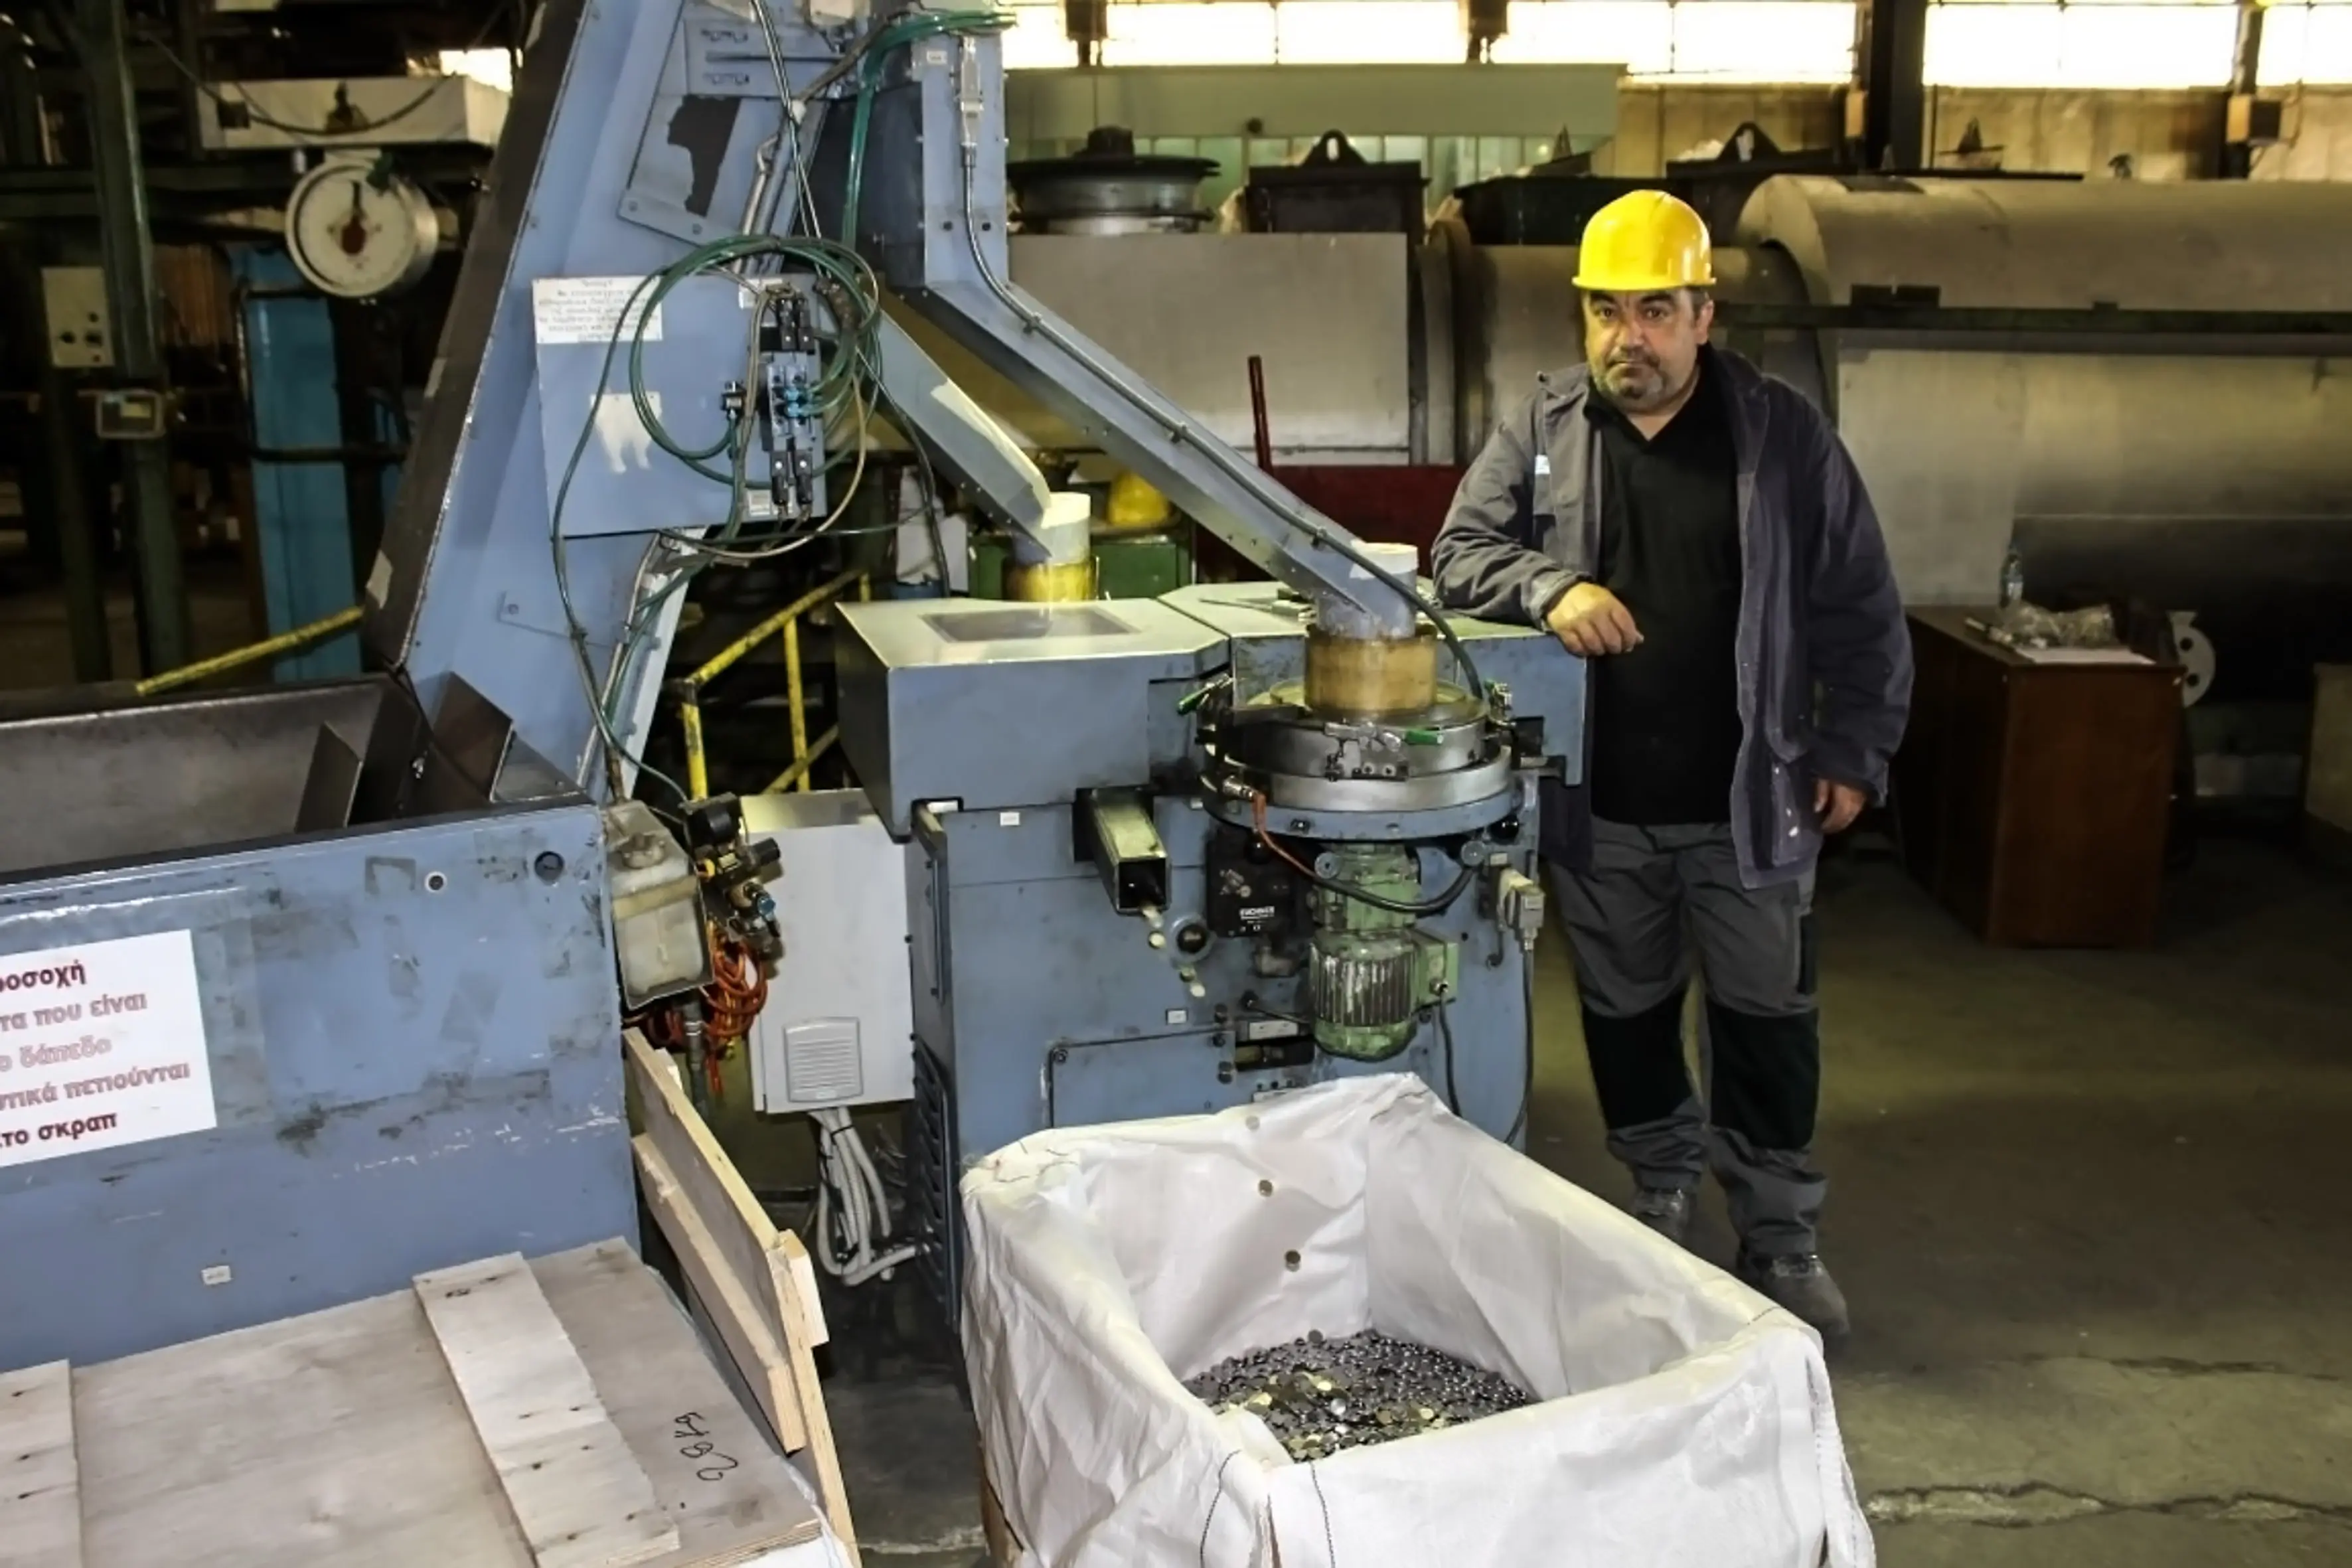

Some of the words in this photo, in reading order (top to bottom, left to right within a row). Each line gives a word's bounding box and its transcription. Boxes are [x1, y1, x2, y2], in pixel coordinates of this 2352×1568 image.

[0, 959, 86, 992] οσοχή
[33, 1002, 82, 1026] που
[90, 993, 147, 1017] είναι
[19, 1034, 112, 1068] δάπεδο
[63, 1062, 191, 1099] πετιούνται
[0, 1129, 29, 1148] το
[38, 1113, 118, 1140] σκραπ
